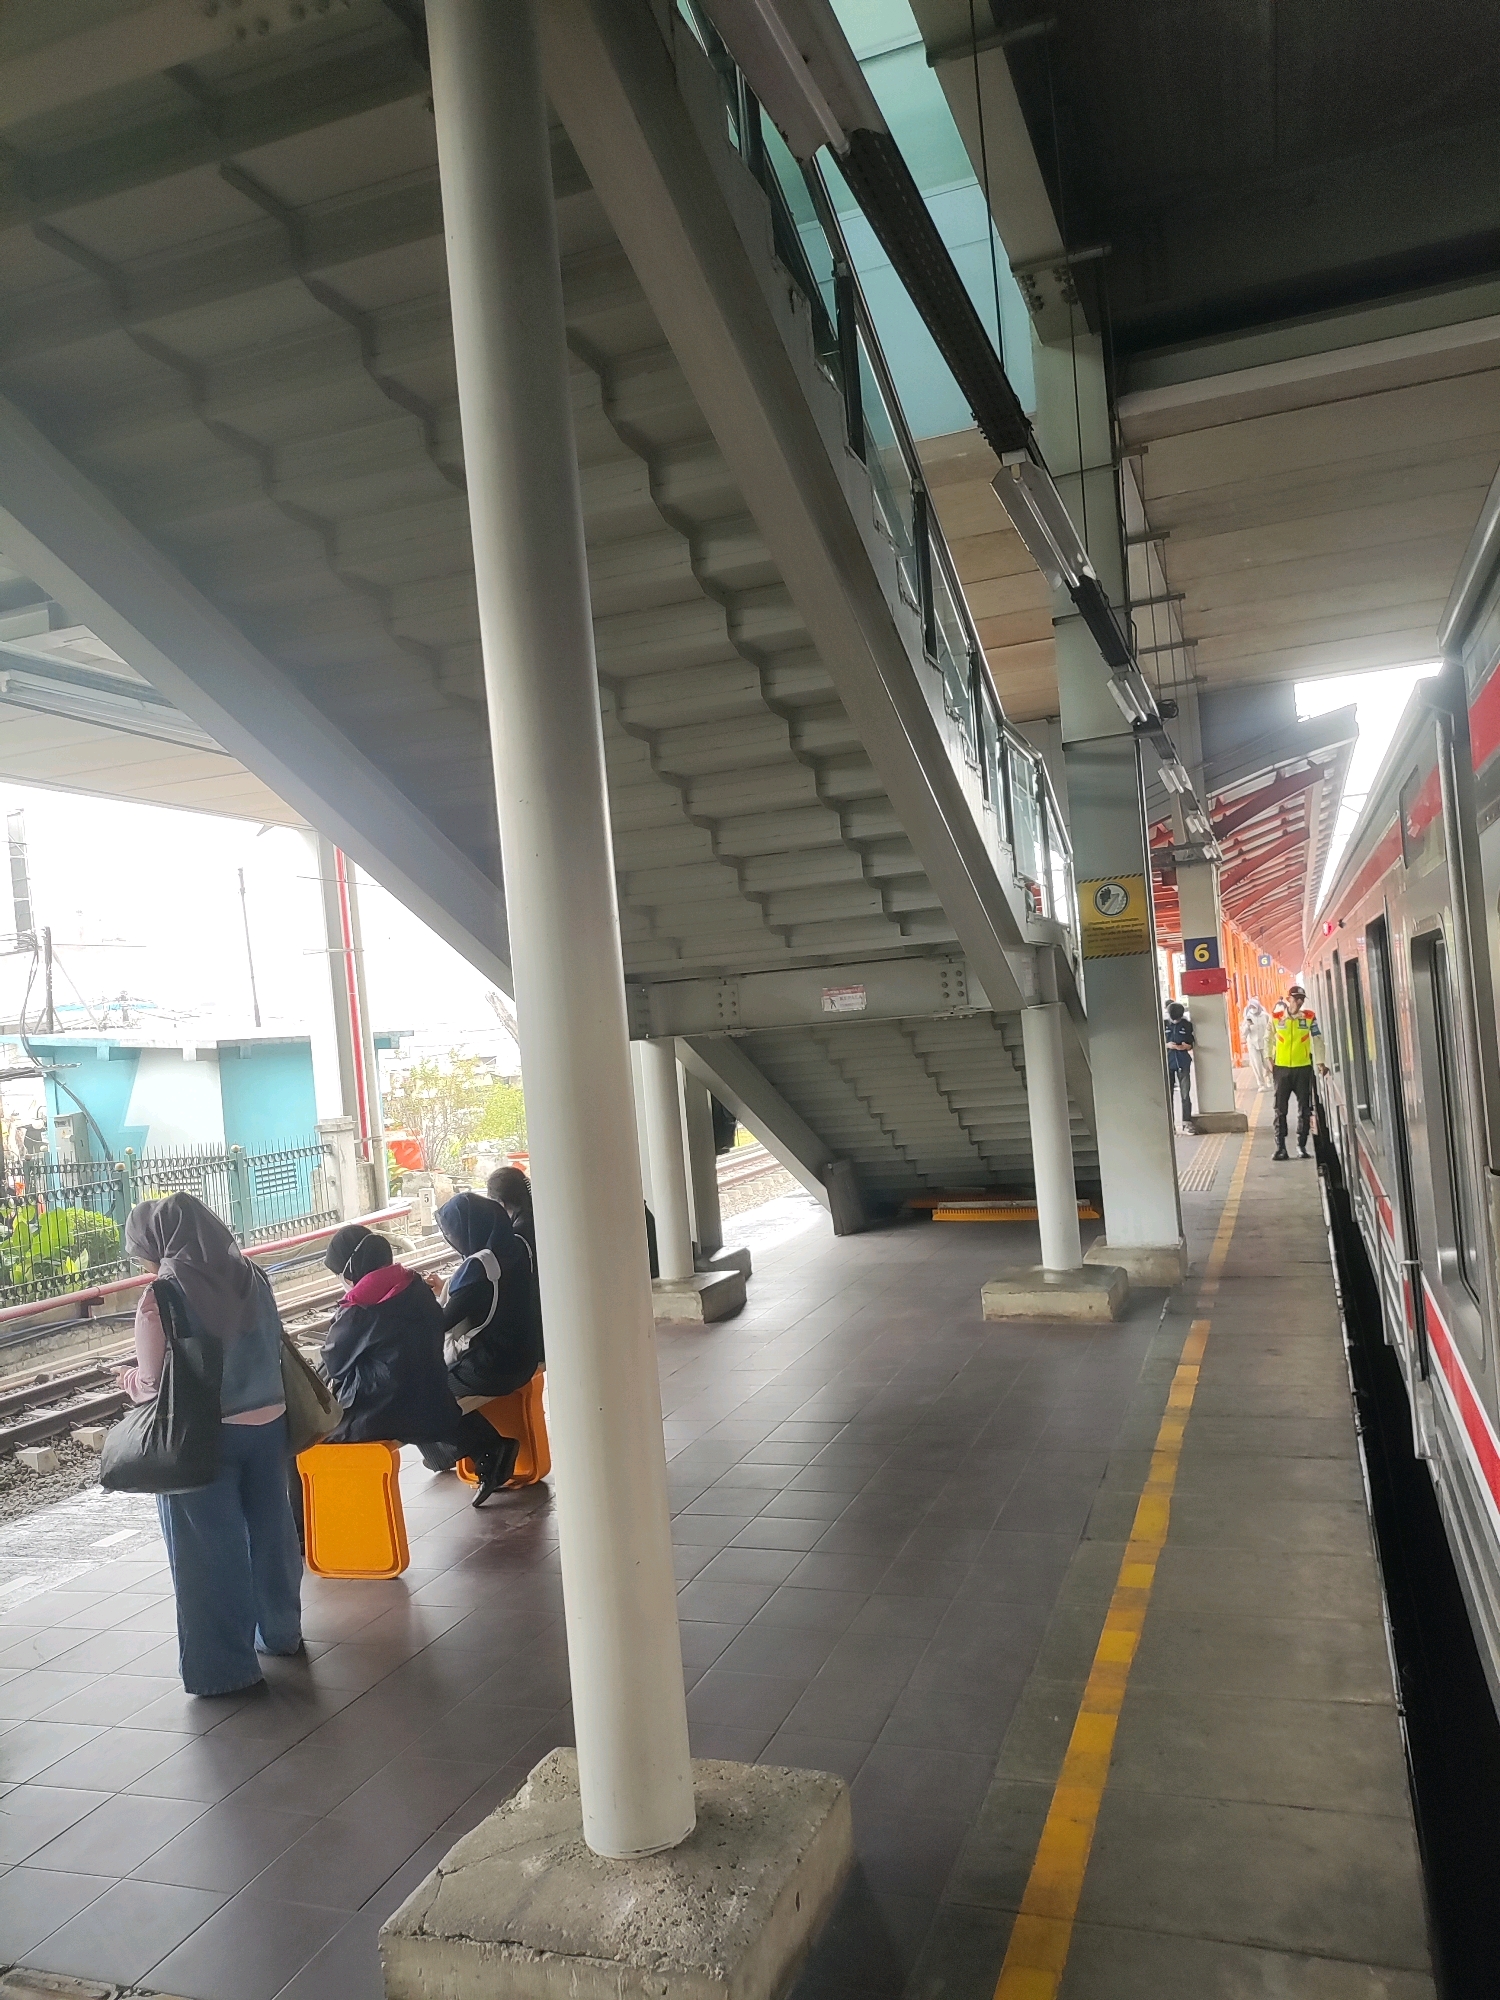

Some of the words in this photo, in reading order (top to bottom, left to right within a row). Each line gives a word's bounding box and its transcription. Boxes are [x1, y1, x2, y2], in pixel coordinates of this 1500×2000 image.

[1194, 943, 1209, 962] 6
[1261, 957, 1268, 965] 6
[424, 1194, 429, 1203] 5
